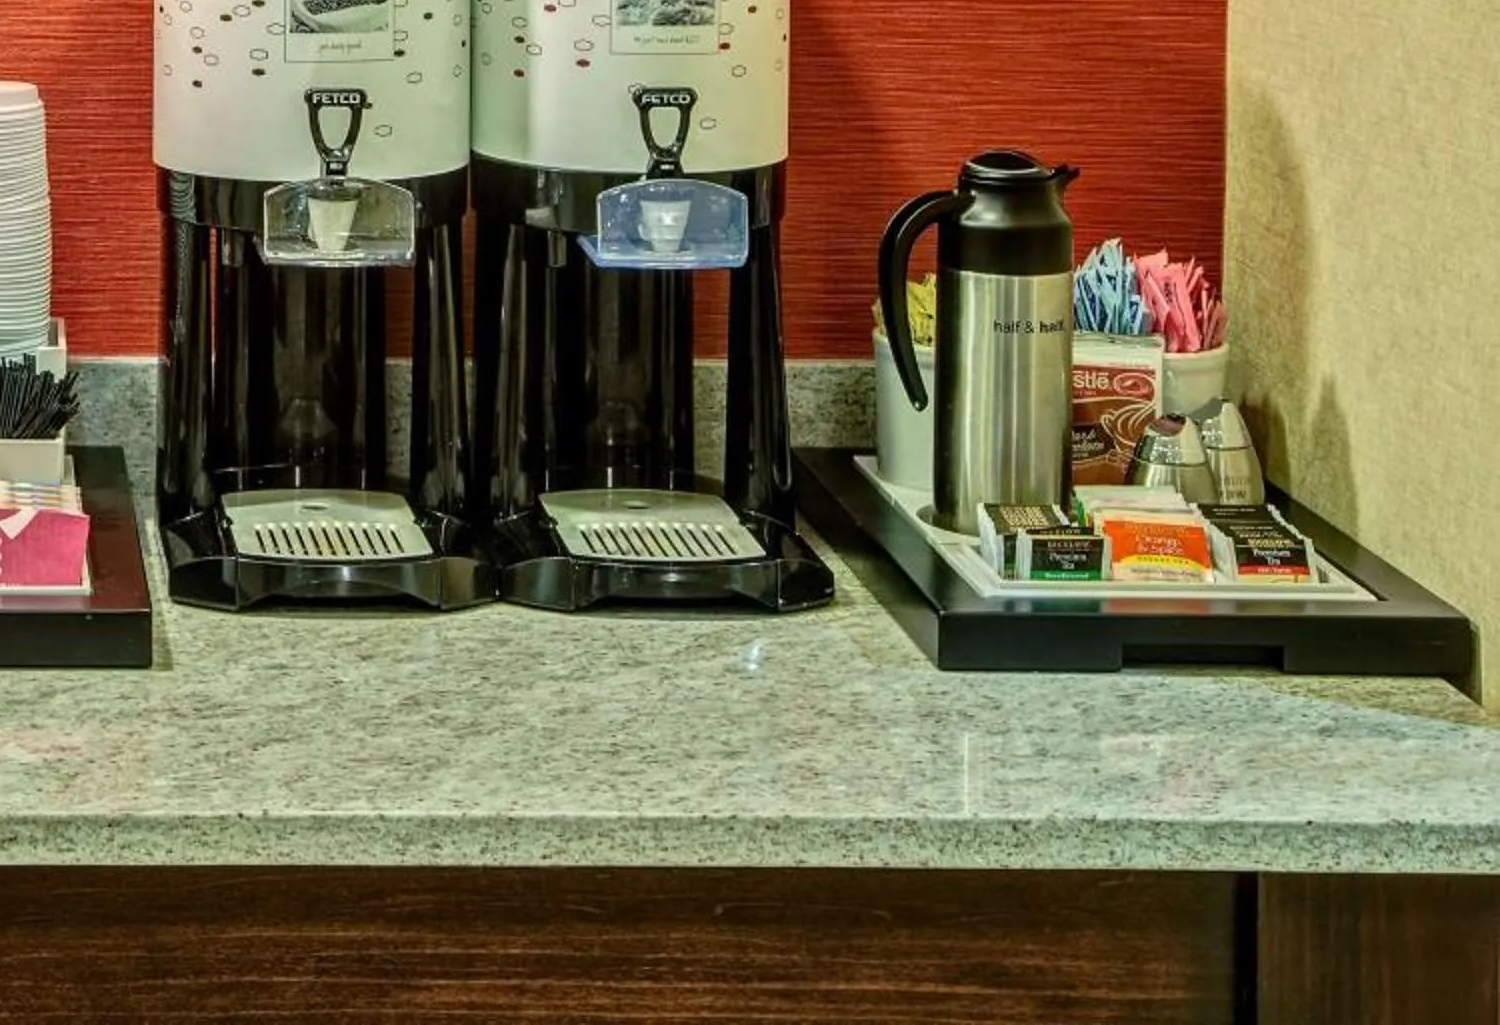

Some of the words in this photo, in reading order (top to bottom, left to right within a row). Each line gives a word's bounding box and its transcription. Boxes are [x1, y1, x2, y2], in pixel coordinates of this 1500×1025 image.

[312, 93, 361, 104] FETCO
[641, 94, 691, 104] FETCO
[993, 320, 1021, 334] half
[1024, 320, 1035, 334] &
